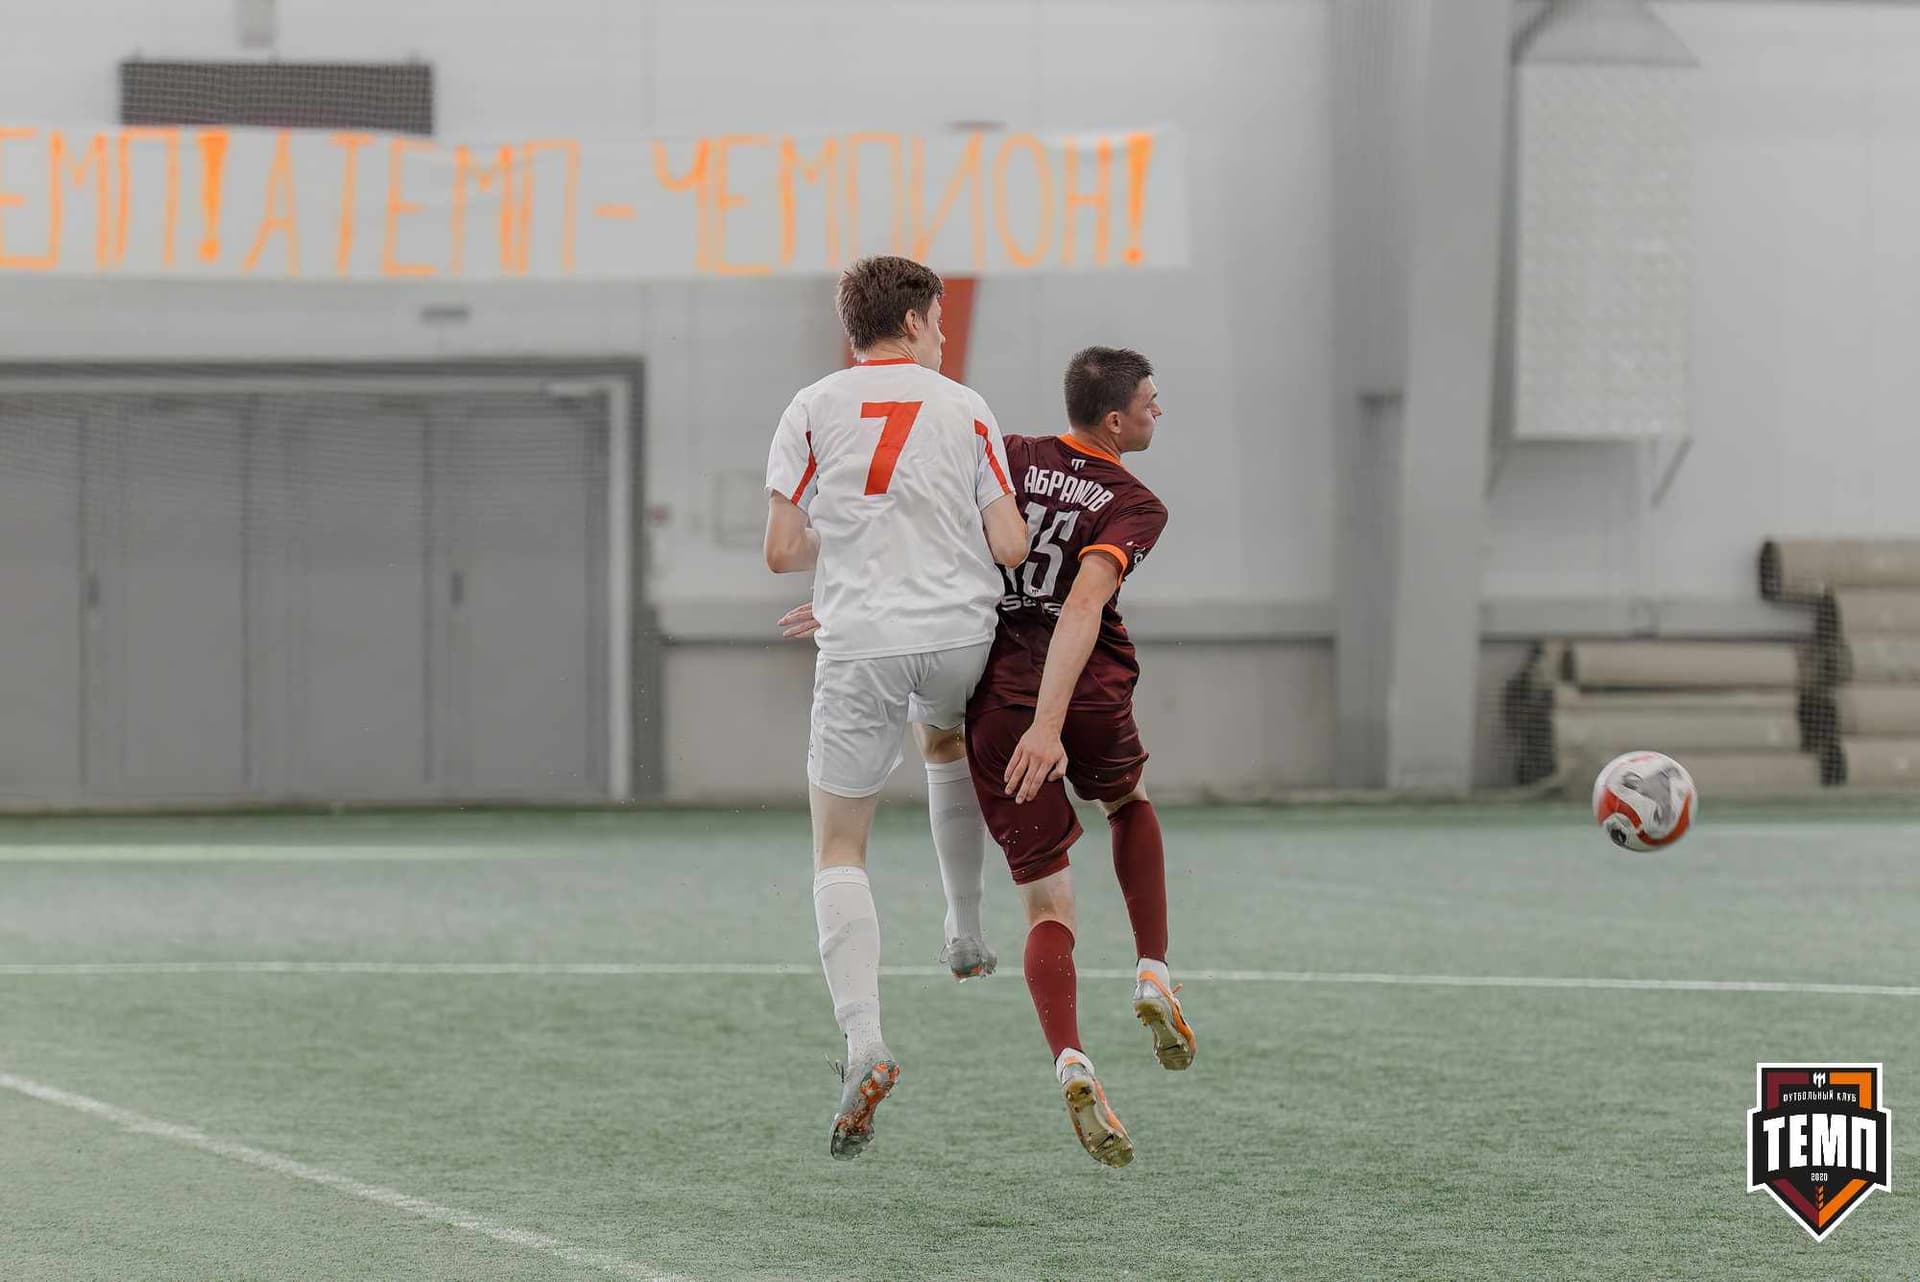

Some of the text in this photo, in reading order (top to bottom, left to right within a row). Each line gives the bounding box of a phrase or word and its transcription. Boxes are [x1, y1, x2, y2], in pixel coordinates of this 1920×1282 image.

[652, 131, 1154, 275] ЧЕМПИОН!
[860, 401, 923, 495] 7
[1024, 465, 1114, 512] АБРАМОВ
